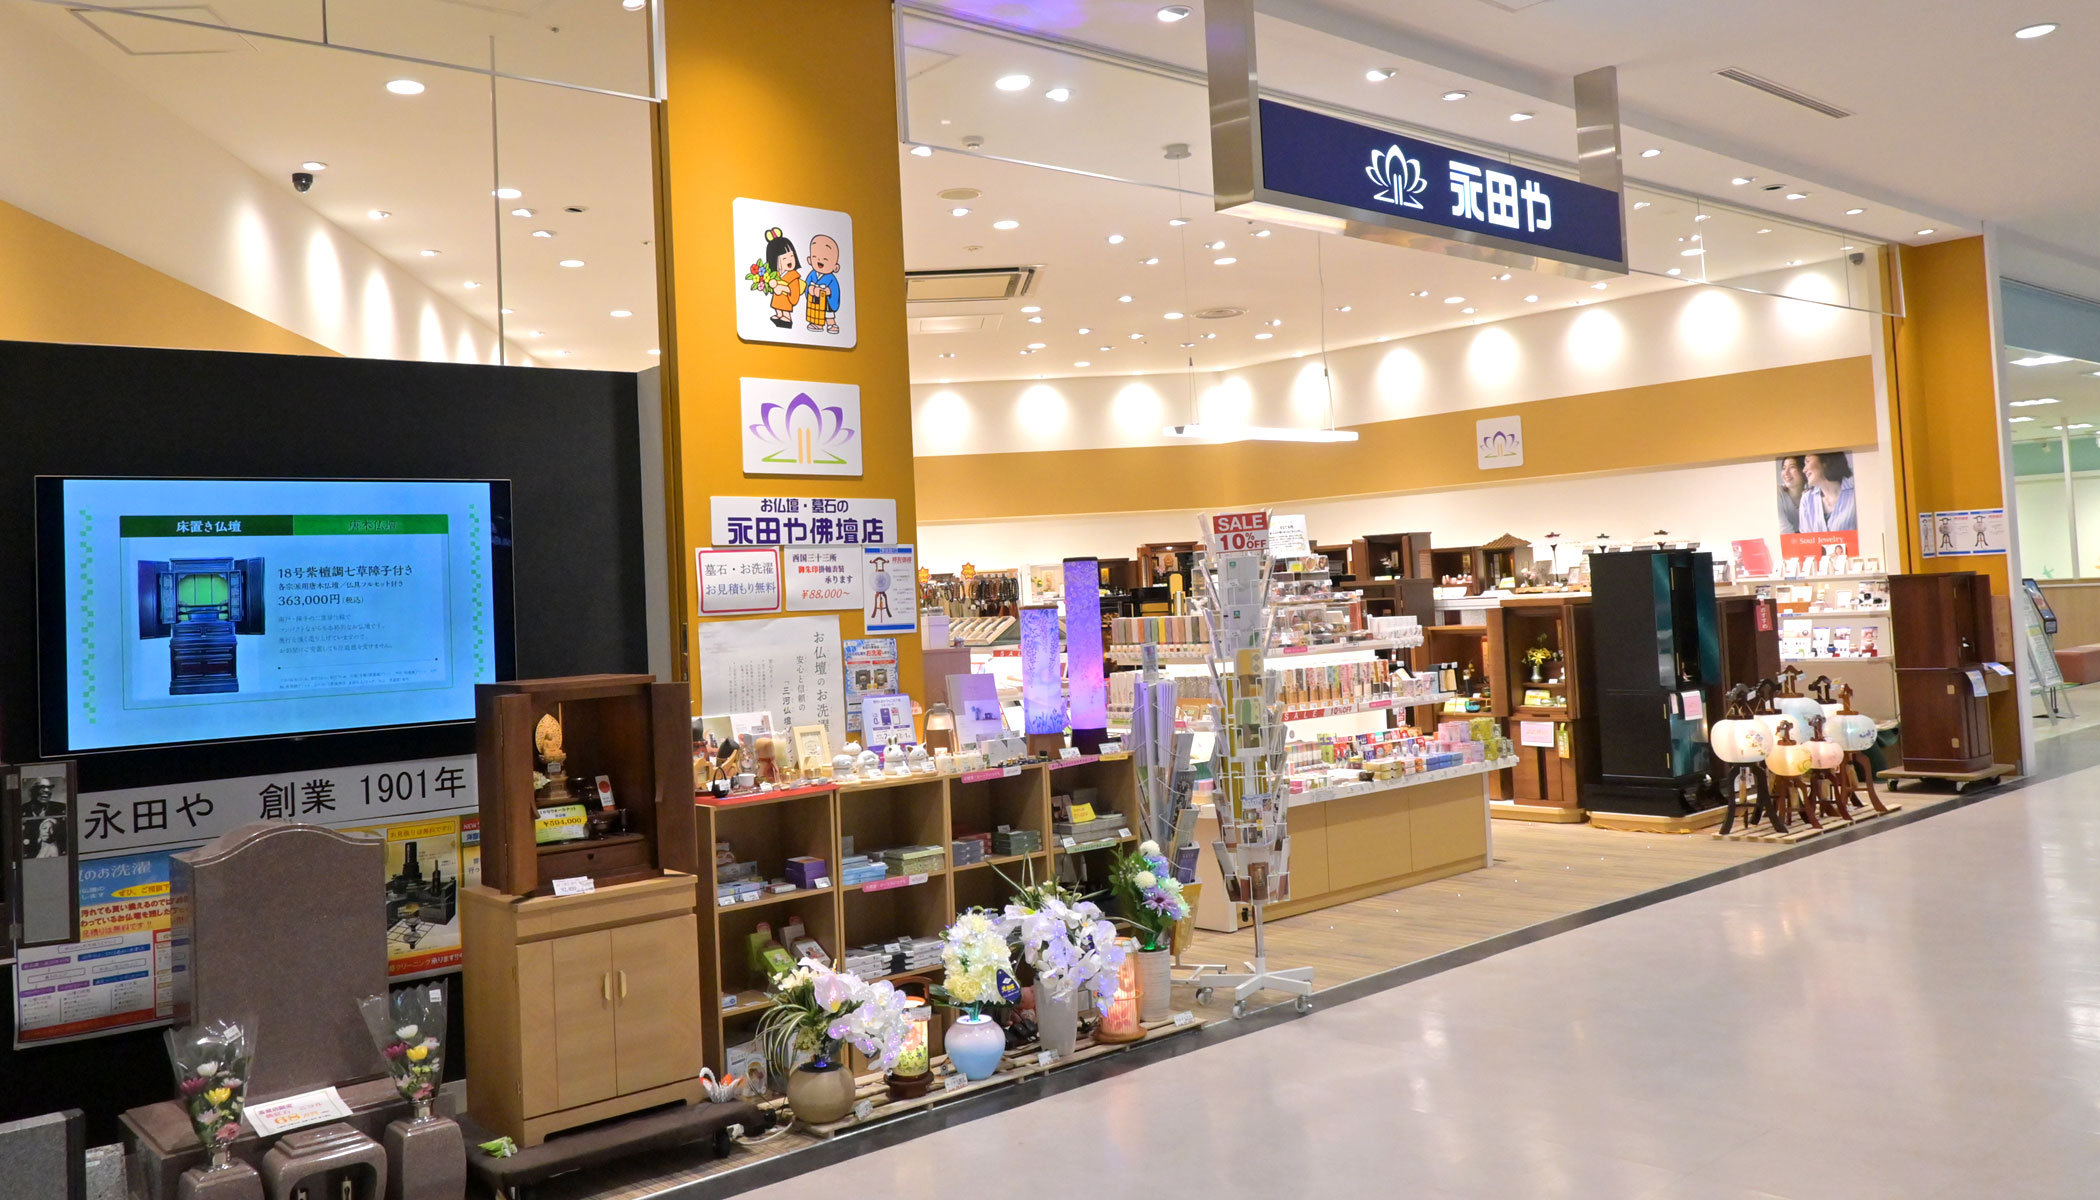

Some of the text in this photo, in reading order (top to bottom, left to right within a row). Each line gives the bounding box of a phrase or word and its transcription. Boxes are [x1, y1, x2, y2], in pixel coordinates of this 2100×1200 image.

[1449, 160, 1552, 232] 永田や
[760, 498, 849, 513] お仏壇・墓石の
[176, 520, 242, 533] 床置き仏壇
[1217, 514, 1264, 532] SALE
[727, 517, 884, 544] 永田や佛壇店
[1246, 539, 1267, 549] OFF
[1817, 536, 1843, 544] Jewelry
[792, 553, 837, 562] 西国三十三所
[278, 564, 413, 579] 18号紫檀調七草障子付き
[705, 562, 774, 576] 墓石・お洗濯
[825, 575, 853, 584] 承ります
[705, 582, 776, 595] お見積もり無料
[1284, 710, 1318, 721] SALE
[84, 766, 467, 840] 永田や 創業 1901年
